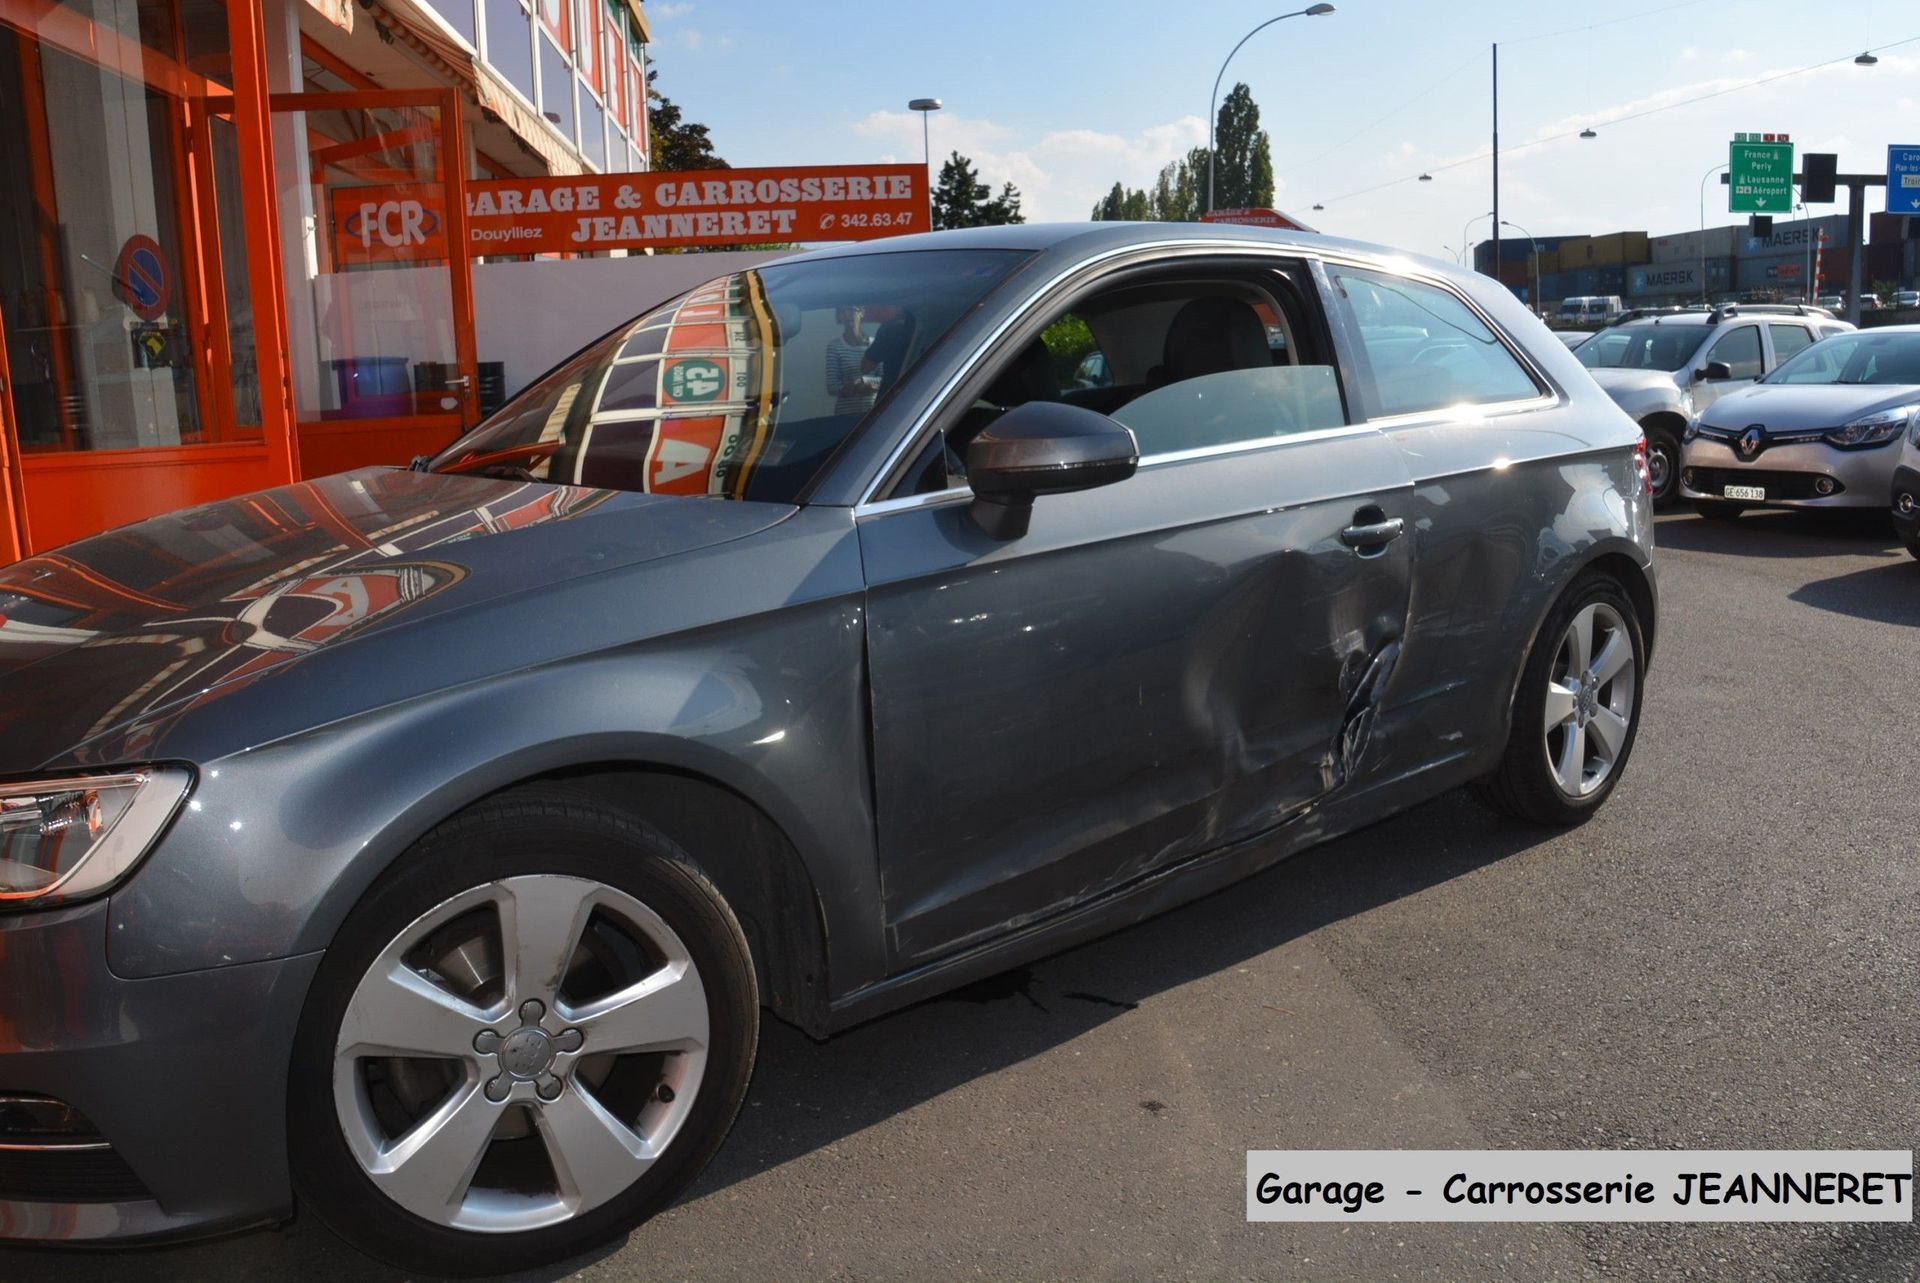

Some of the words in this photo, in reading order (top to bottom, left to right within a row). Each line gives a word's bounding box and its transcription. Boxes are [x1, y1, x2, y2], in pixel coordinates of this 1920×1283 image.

[1744, 150, 1771, 159] France
[1751, 161, 1772, 172] Perly
[1747, 175, 1785, 184] Lausanne
[614, 185, 641, 209] &
[655, 175, 912, 208] CARROSSERIE
[1752, 186, 1787, 196] Aéroport
[360, 200, 426, 248] FCR
[571, 209, 797, 242] JEANNERET
[841, 212, 913, 228] 342.63.47
[471, 226, 543, 243] Douylliez
[1761, 228, 1820, 248] MAERSK
[1646, 270, 1694, 287] MAERSK
